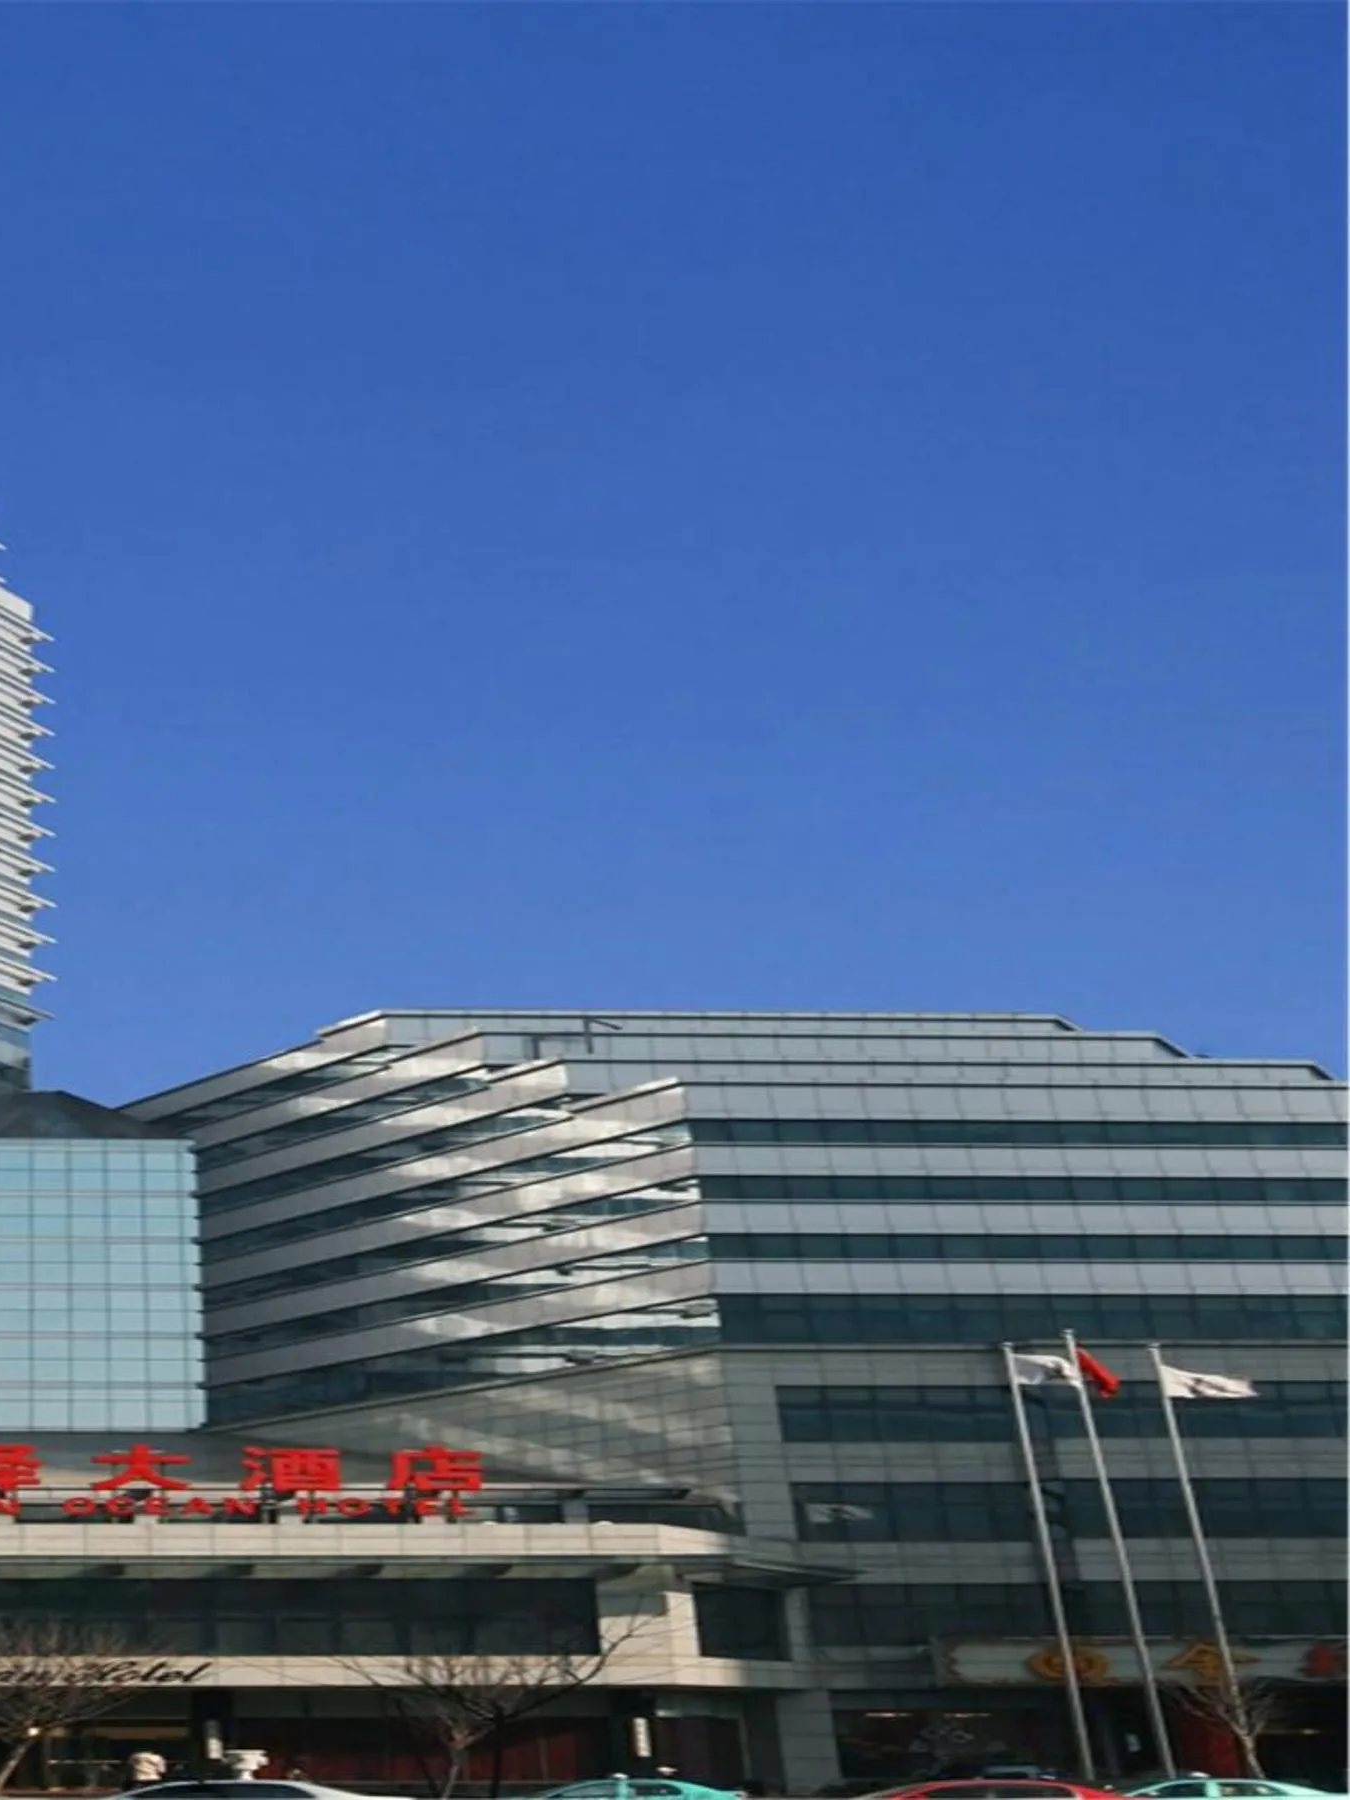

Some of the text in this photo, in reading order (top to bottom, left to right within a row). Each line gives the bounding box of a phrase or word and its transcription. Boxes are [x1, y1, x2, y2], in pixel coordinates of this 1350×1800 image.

[62, 1496, 258, 1517] OCEAN
[296, 1496, 474, 1518] HOTEL
[63, 1660, 213, 1684] Hotel
